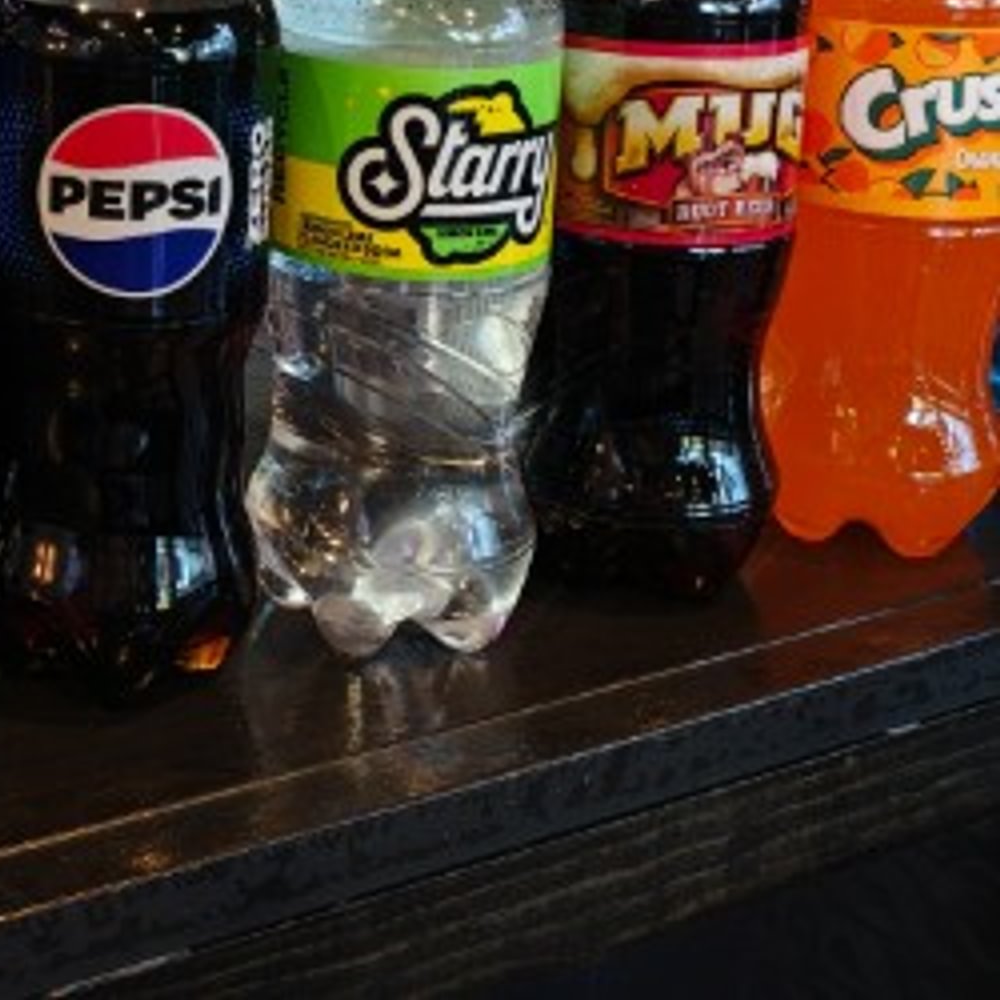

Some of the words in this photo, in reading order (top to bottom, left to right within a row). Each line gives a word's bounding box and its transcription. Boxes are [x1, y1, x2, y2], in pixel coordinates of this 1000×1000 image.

[841, 65, 1000, 156] Crus
[48, 175, 222, 221] PEPSI
[347, 103, 553, 234] Starry
